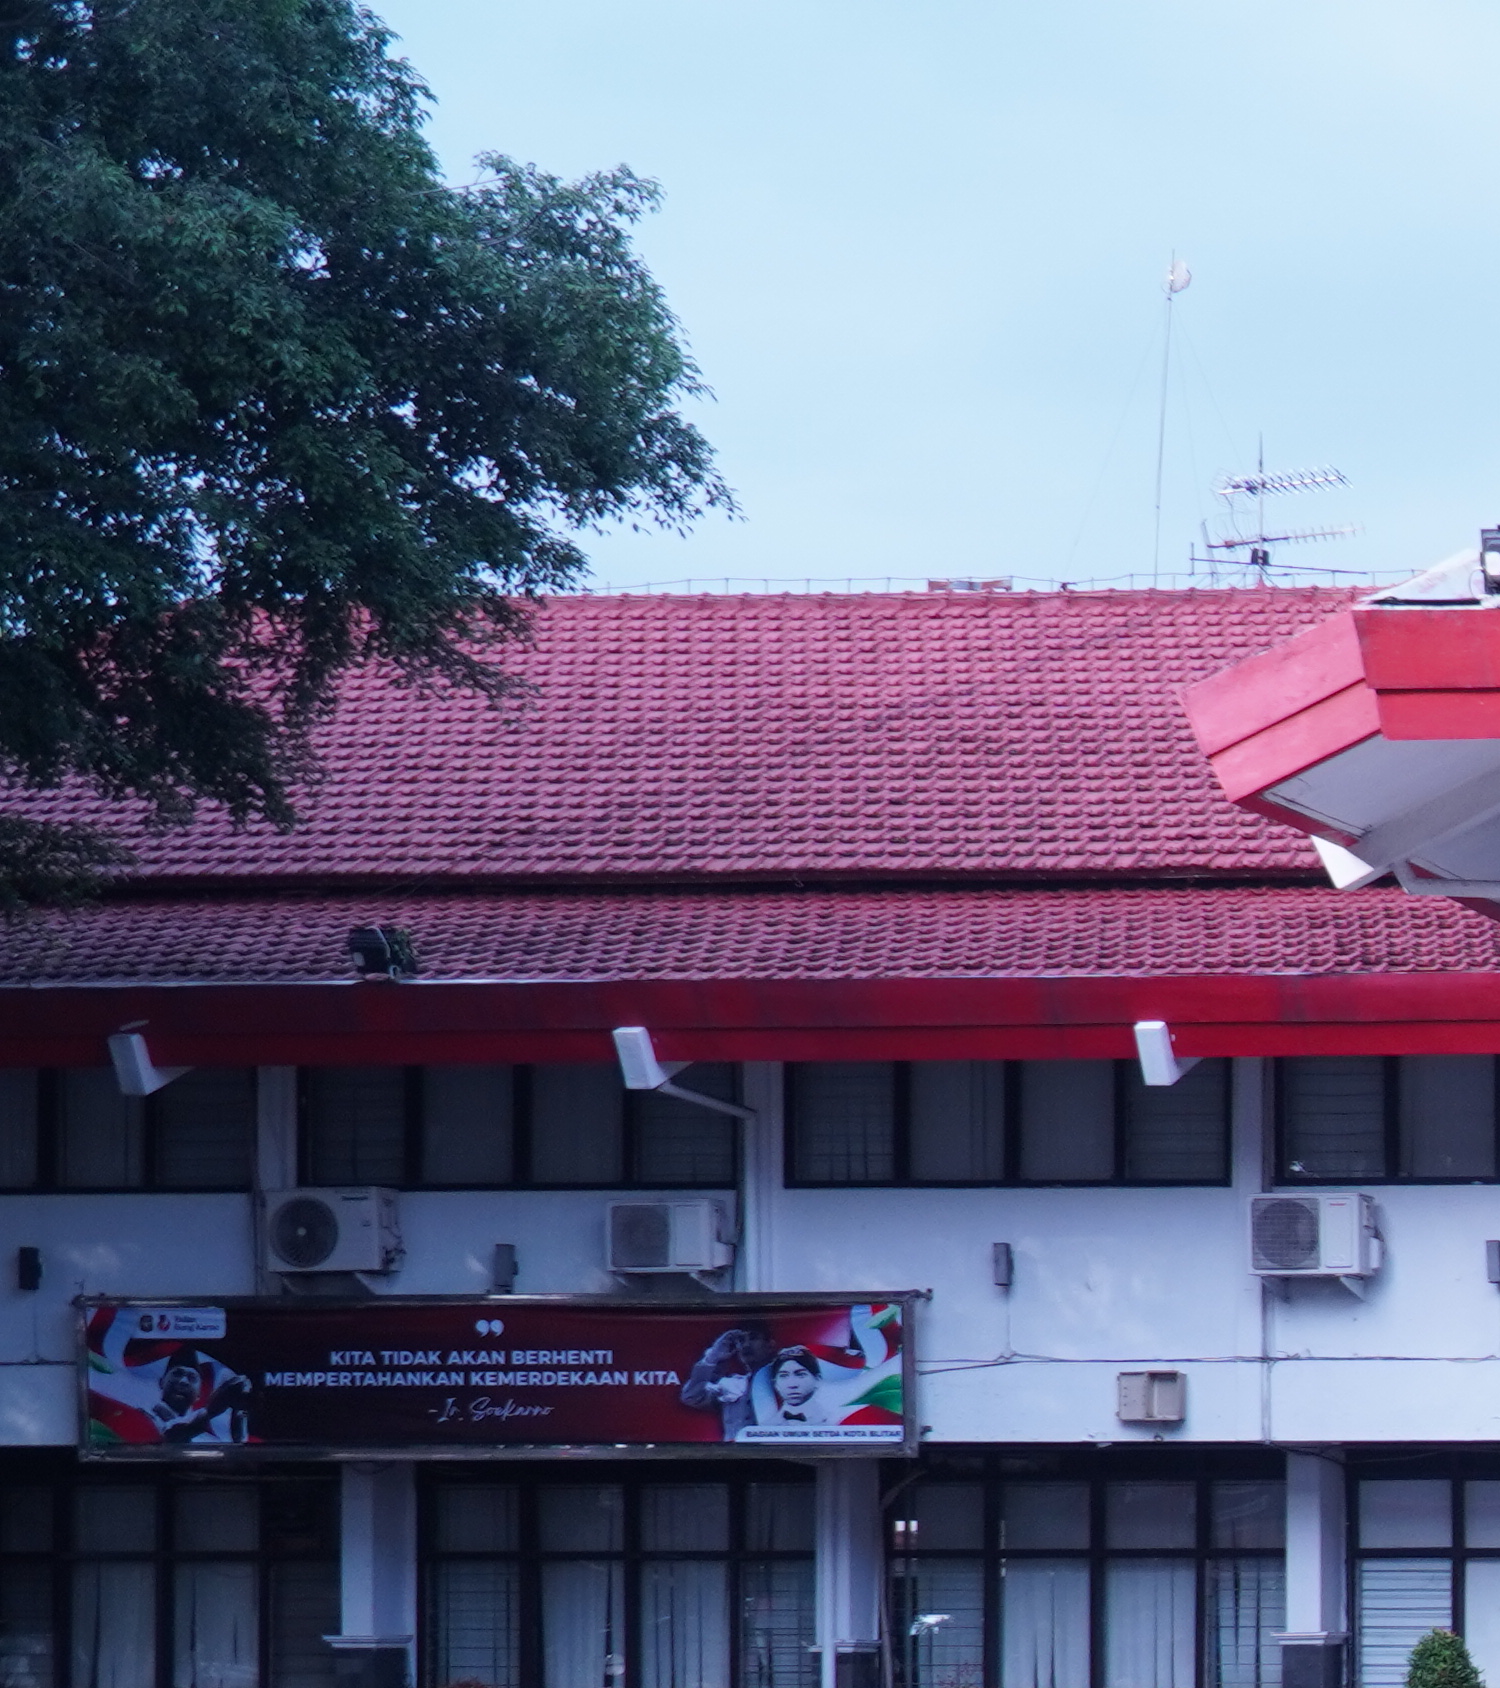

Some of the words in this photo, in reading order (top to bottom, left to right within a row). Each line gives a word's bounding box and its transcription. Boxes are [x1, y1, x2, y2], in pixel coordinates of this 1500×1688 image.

[330, 1351, 376, 1365] KITA
[380, 1351, 442, 1365] TIDAK
[446, 1351, 505, 1365] AKAN
[511, 1350, 613, 1365] BERHENTI
[264, 1372, 465, 1386] MEMPERTAHANKAN
[470, 1371, 628, 1386] KEMERDEKAAN
[634, 1371, 681, 1385] KITA
